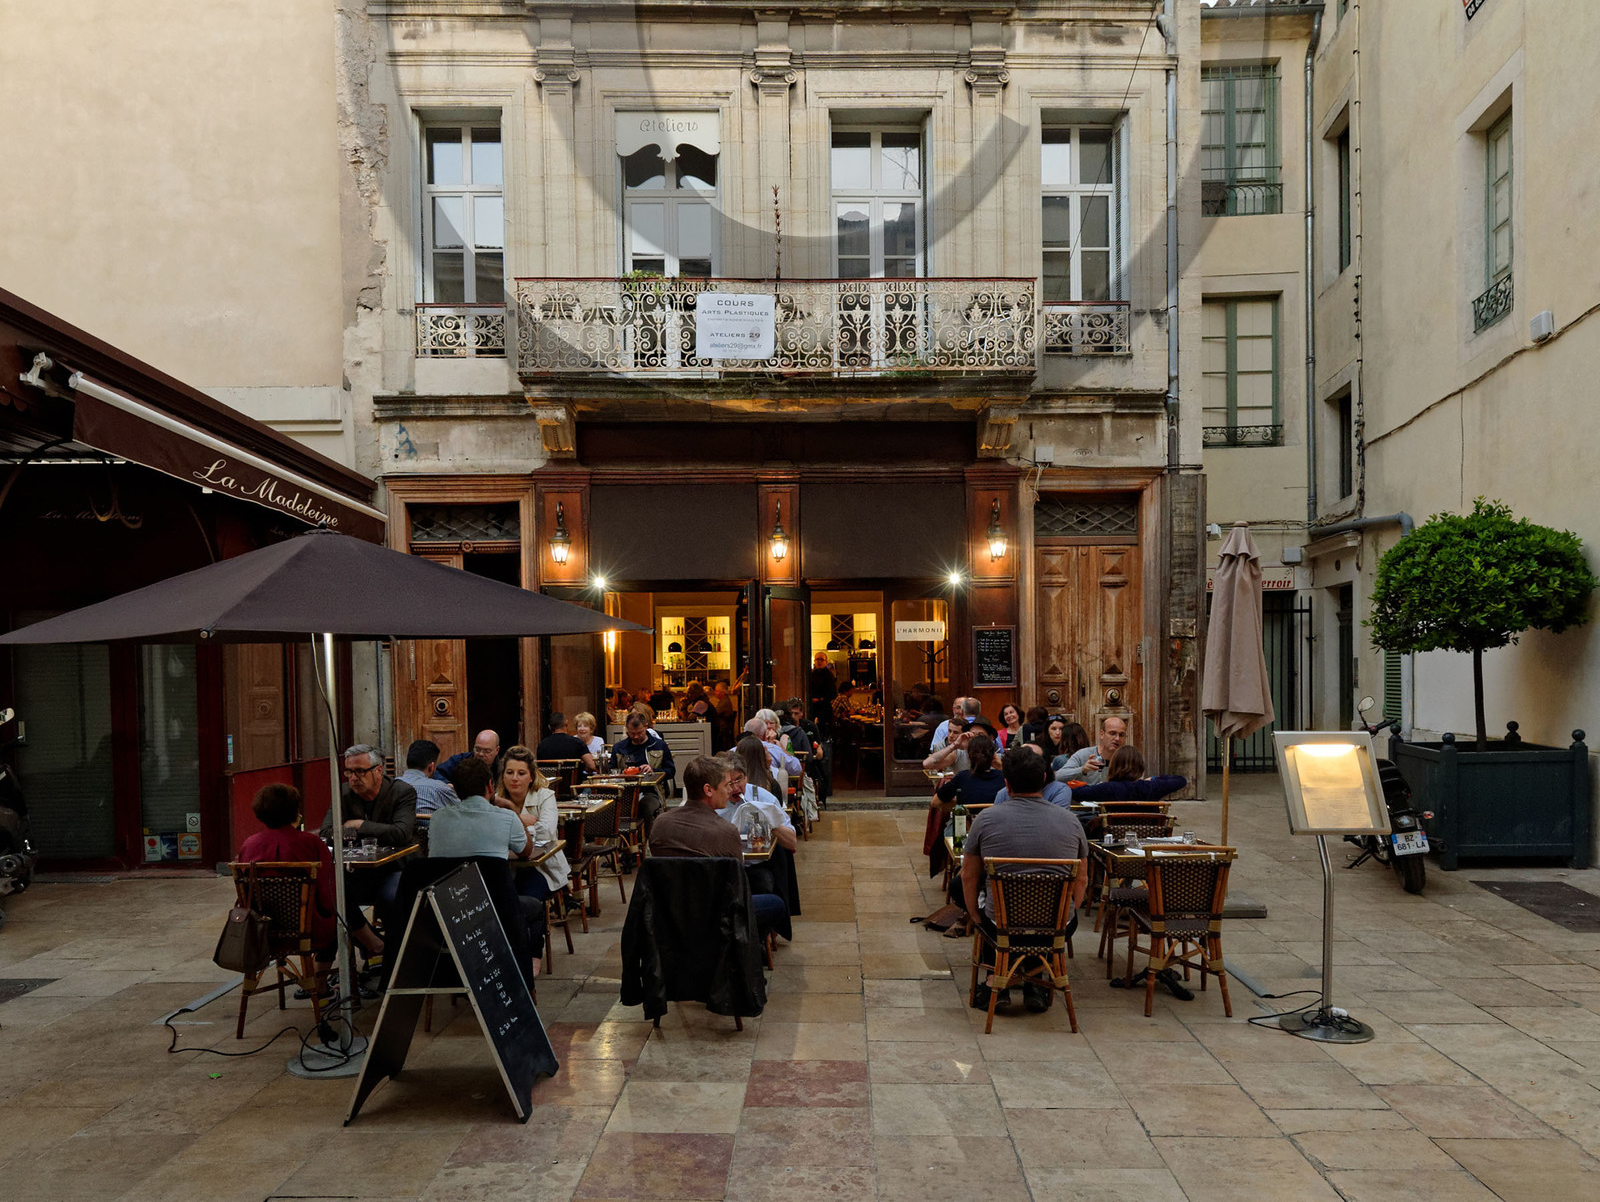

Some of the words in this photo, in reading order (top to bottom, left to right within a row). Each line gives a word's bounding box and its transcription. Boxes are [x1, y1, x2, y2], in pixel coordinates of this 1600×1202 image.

[640, 118, 698, 132] Ateliers
[192, 458, 237, 490] La
[240, 478, 338, 527] Madeleine
[1261, 576, 1292, 588] erroir
